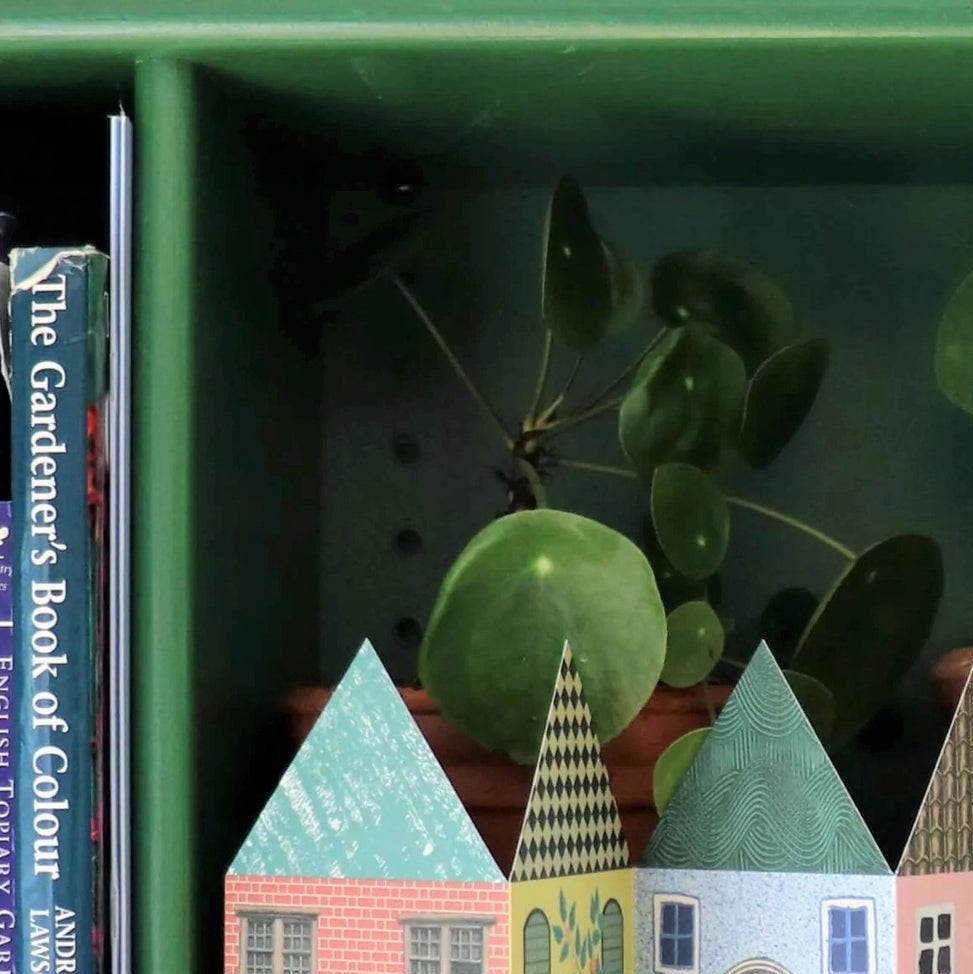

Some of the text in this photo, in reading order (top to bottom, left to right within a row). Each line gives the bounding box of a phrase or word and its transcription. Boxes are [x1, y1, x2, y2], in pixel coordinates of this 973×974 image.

[29, 273, 69, 881] The Gardener's Book of Colour
